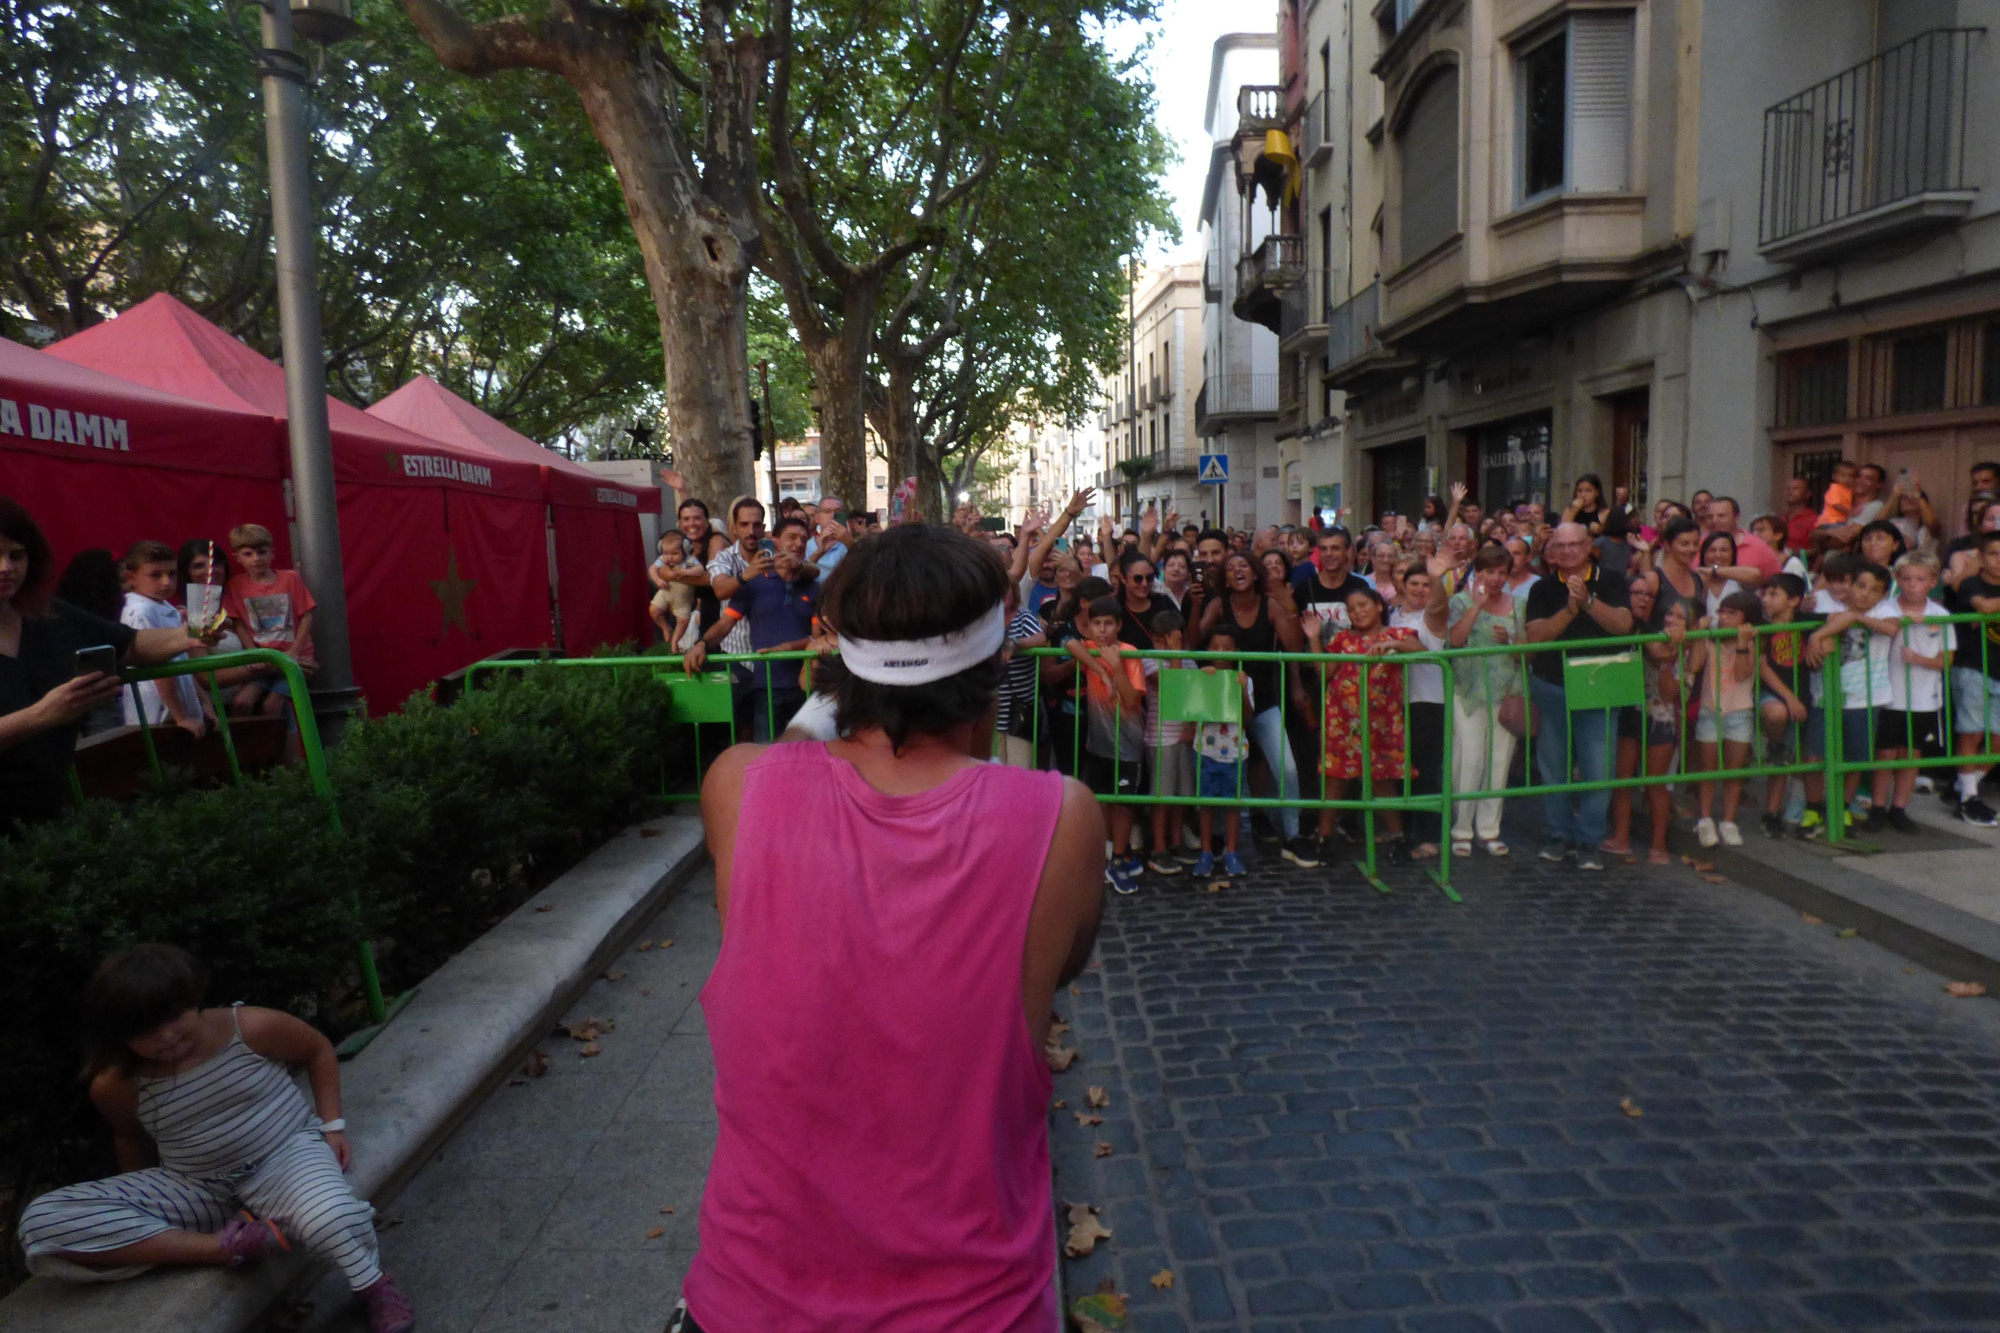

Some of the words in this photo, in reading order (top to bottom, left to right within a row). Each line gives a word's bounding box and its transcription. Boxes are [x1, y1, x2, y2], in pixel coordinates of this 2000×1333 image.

[27, 403, 130, 451] DAMM
[402, 454, 460, 480] ESTRELLA
[460, 461, 492, 487] DAMM
[883, 659, 929, 668] ARTENGO
